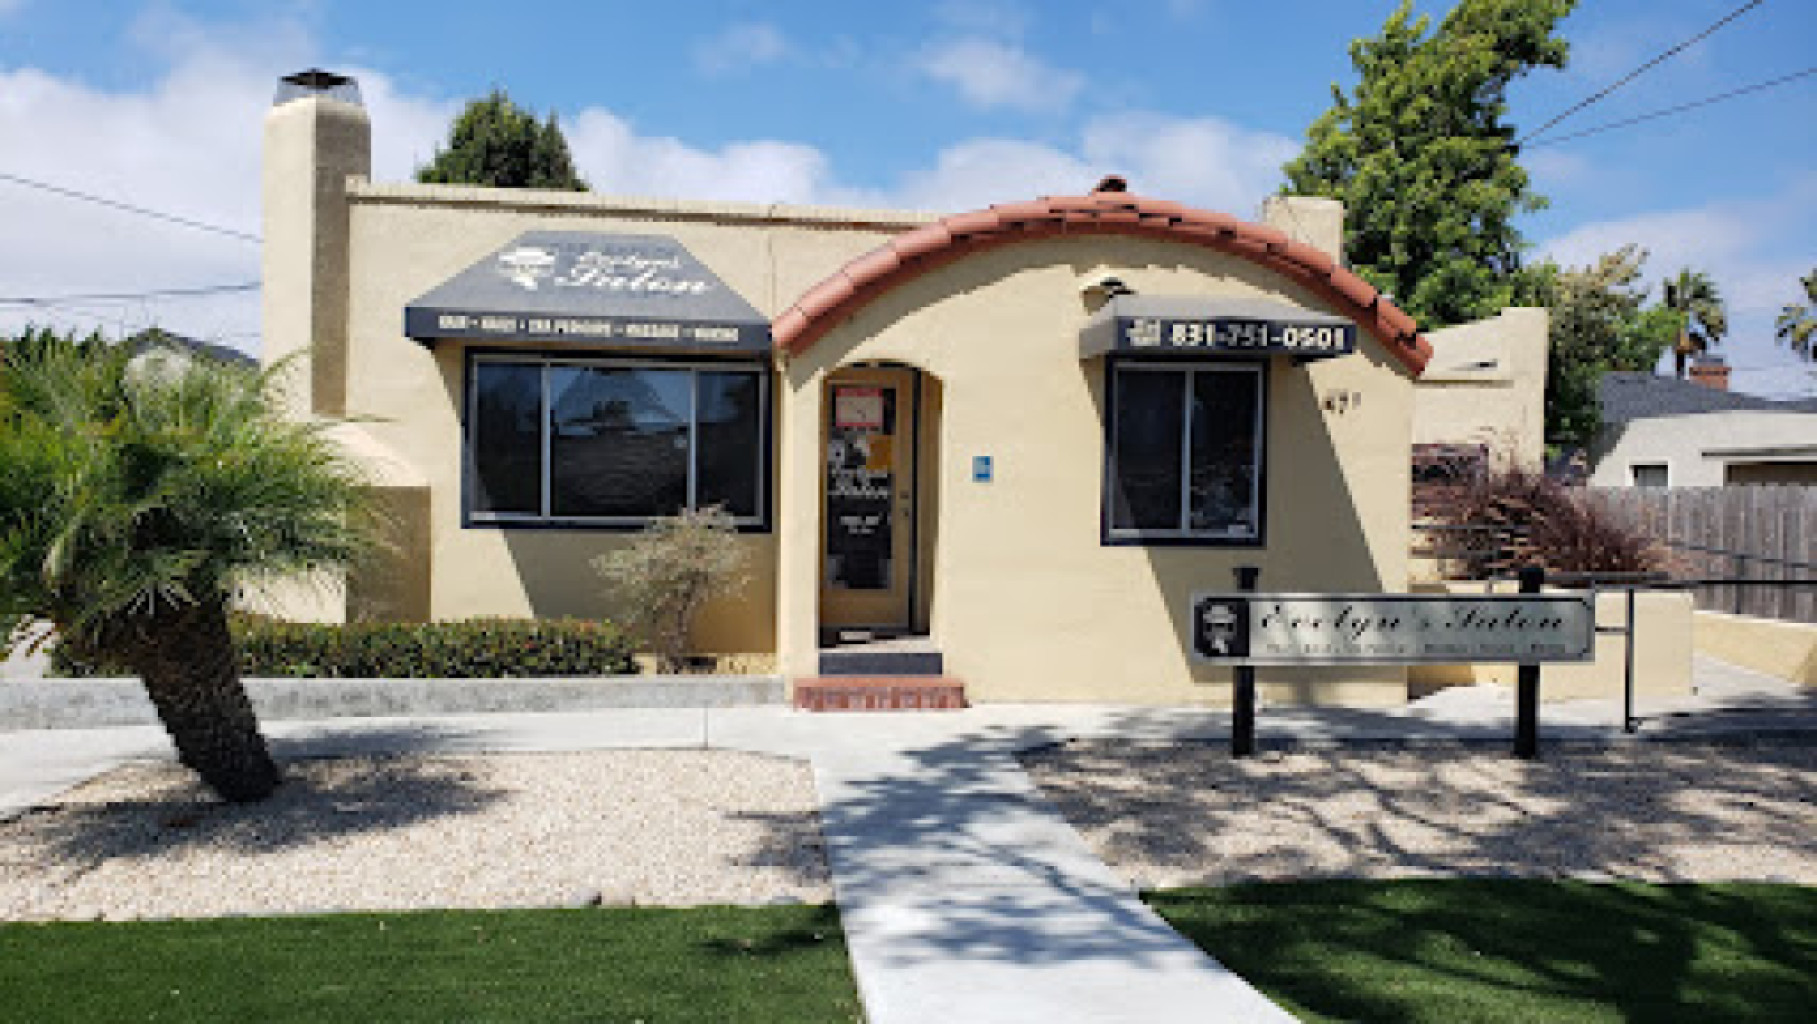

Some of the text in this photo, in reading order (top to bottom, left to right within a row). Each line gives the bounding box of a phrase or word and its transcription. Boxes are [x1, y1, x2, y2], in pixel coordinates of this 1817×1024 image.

[555, 264, 712, 295] Salon
[1261, 604, 1564, 640] Evelyn's Salon
